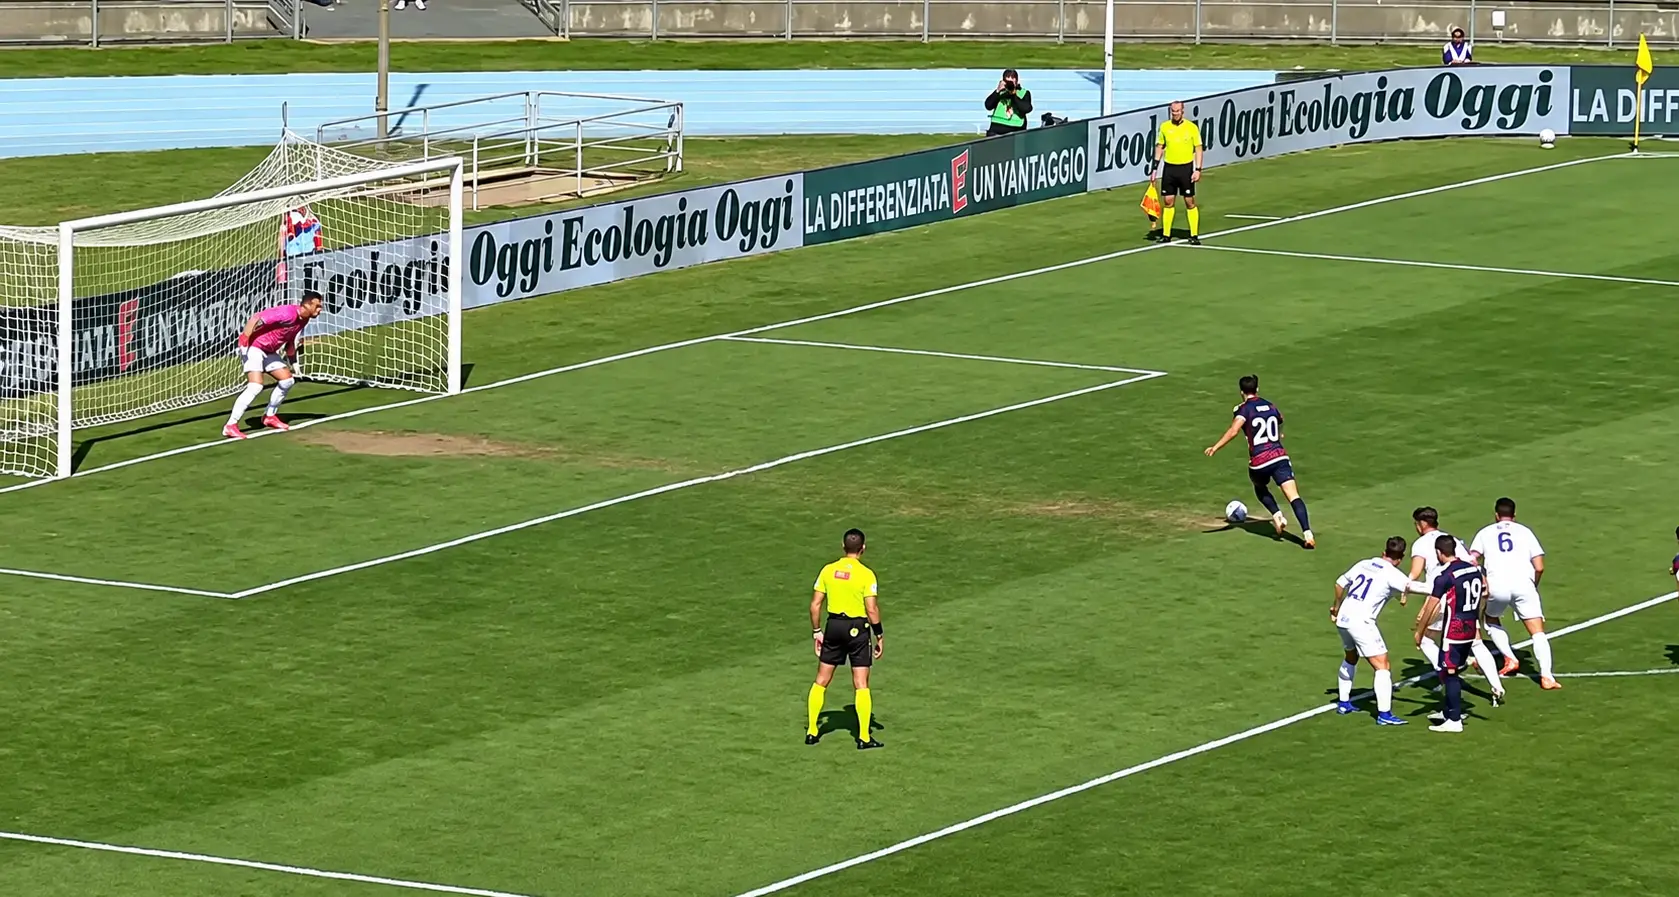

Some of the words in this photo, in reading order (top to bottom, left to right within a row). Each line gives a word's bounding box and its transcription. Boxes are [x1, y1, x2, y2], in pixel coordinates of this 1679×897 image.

[1219, 91, 1275, 158] Oggi
[1278, 76, 1415, 139] Ecologia
[1425, 69, 1553, 130] Oggi
[1573, 88, 1609, 122] LA
[1617, 88, 1679, 122] DIFF
[805, 195, 826, 234] LA
[830, 172, 950, 230] DIFFERENZIATA
[973, 164, 995, 203] UN
[998, 146, 1085, 197] VANTAGGIO
[470, 219, 553, 297] Oggi
[560, 196, 708, 271] Ecologia
[715, 178, 794, 253] Oggi
[1252, 416, 1278, 446] 20
[1498, 532, 1513, 552] 6
[1348, 574, 1373, 601] 21
[1462, 578, 1482, 612] 19
